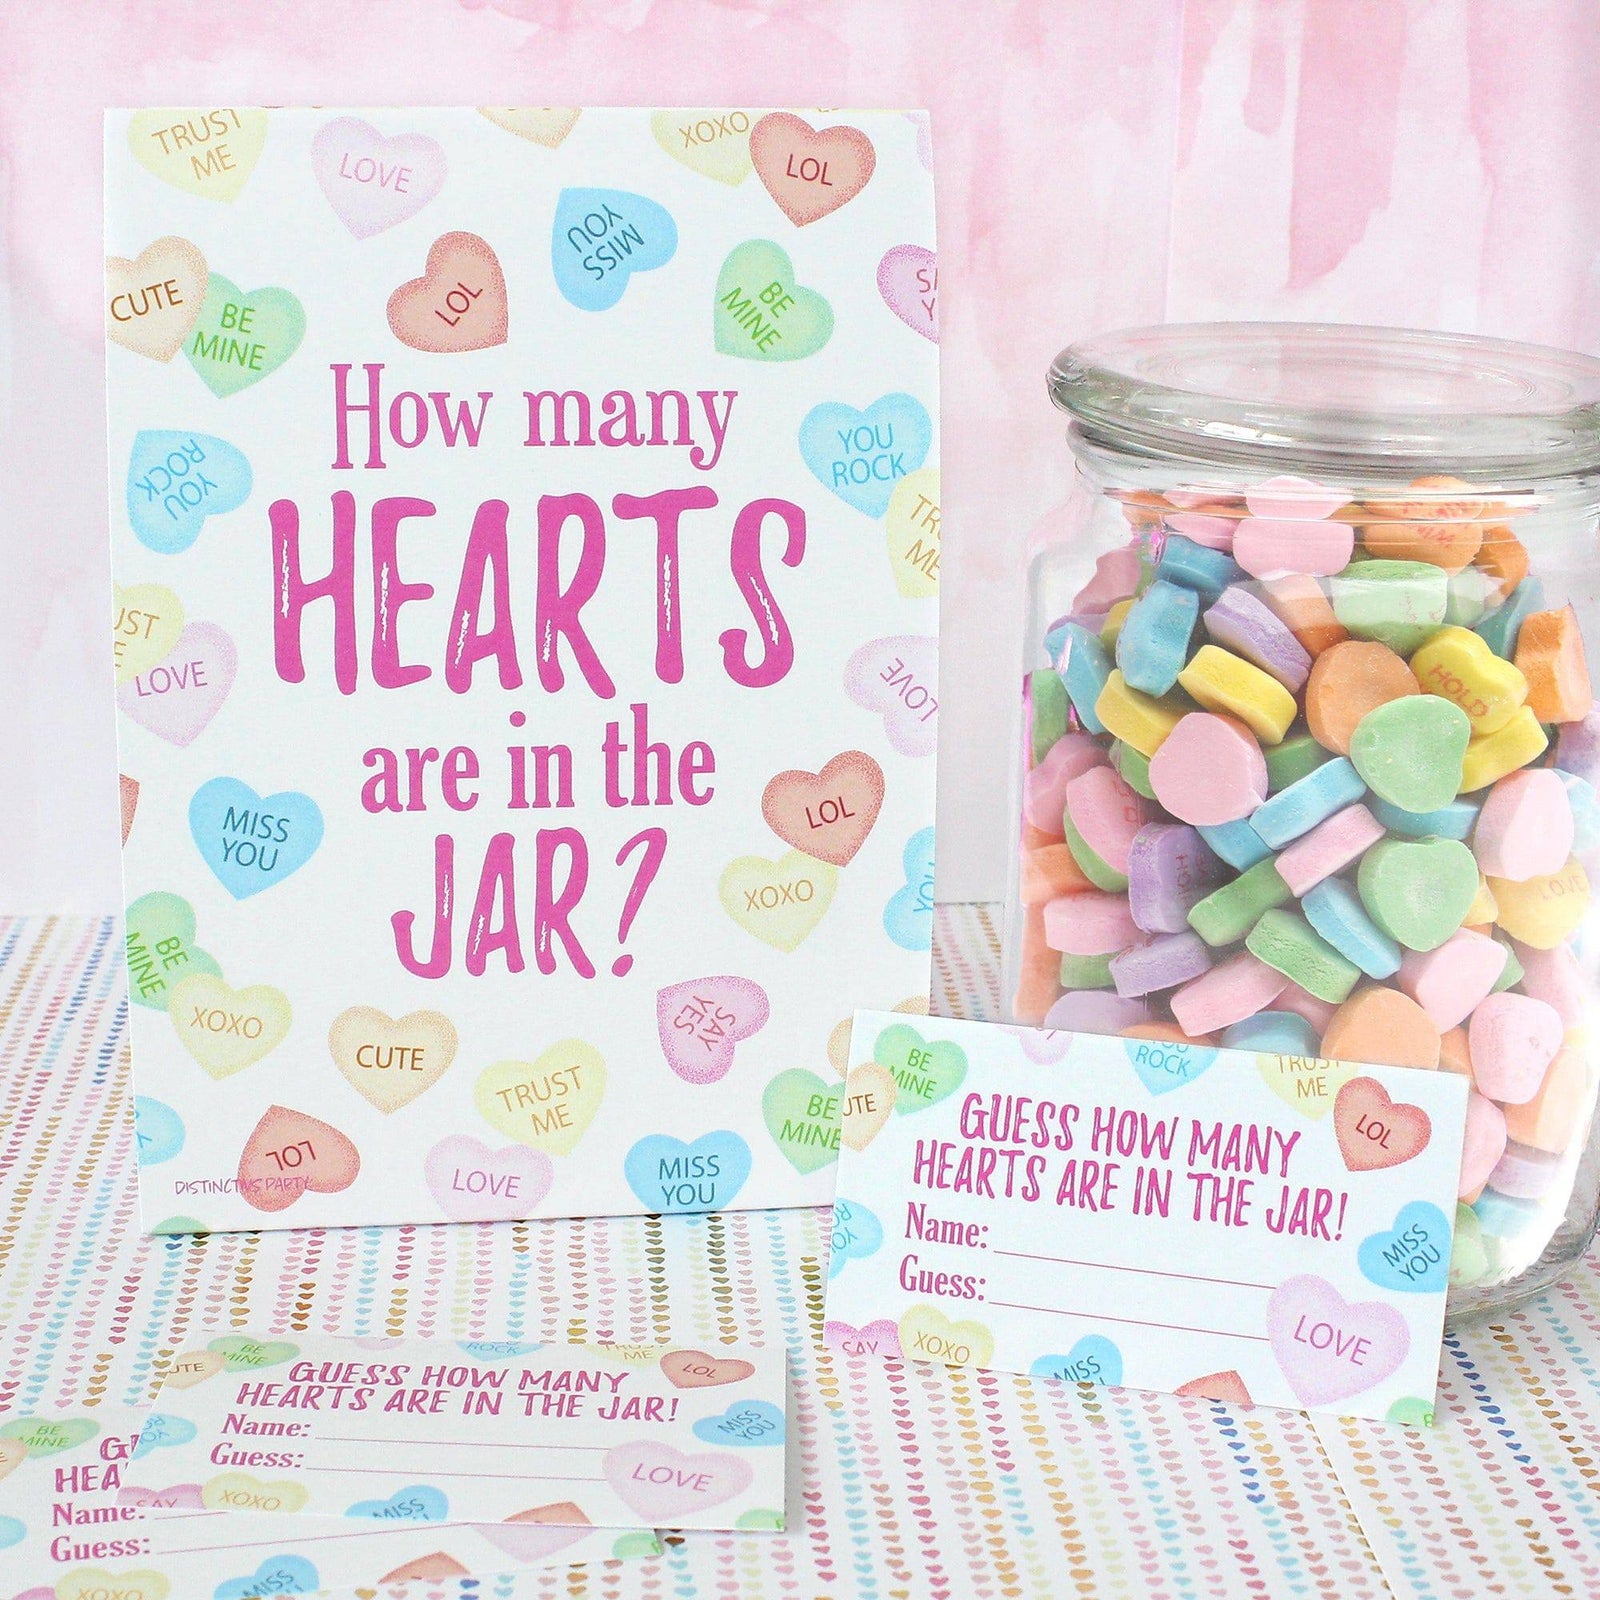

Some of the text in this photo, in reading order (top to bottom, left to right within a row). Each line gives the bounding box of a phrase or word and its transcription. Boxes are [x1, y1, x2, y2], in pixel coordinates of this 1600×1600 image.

[152, 107, 242, 156] TRUST
[679, 111, 750, 149] XOXO
[190, 144, 237, 181] ME
[338, 153, 413, 194] LOVE
[786, 154, 833, 187] LOL
[567, 203, 623, 254] YOU
[583, 223, 645, 281] MISS
[110, 279, 183, 322] CUTE
[434, 282, 484, 328] LOL
[758, 281, 795, 318] BE
[219, 302, 256, 334] BE
[720, 287, 782, 353] MINE
[192, 330, 266, 372] MINE
[329, 363, 739, 471] How many
[837, 423, 894, 455] YOU
[135, 438, 207, 502] ROCK
[832, 453, 908, 488] ROCK
[163, 472, 219, 521] YOU
[268, 485, 807, 699] HEARTS
[135, 661, 208, 697] LOVE
[879, 657, 940, 723] LOVE
[1427, 664, 1489, 718] HOLD
[361, 703, 716, 814] are in the
[223, 806, 291, 843] MISS
[805, 796, 855, 829] LOL
[222, 837, 278, 872] YOU
[391, 827, 667, 980] JAR?
[744, 879, 815, 912] XOXO
[126, 931, 167, 999] MINE
[155, 936, 189, 971] BE
[190, 1006, 263, 1039] XOXO
[673, 995, 715, 1035] YES
[697, 1006, 736, 1052] SAY
[356, 1044, 425, 1072] CUTE
[907, 1048, 933, 1072] BE
[1135, 1044, 1192, 1077] ROCK
[496, 1066, 584, 1113] TRUST
[1297, 1076, 1328, 1098] ME
[530, 1103, 574, 1136] ME
[806, 1094, 839, 1120] BE
[780, 1119, 841, 1151] MINE
[960, 1092, 1301, 1177] GUESS HOW MANY
[1355, 1113, 1393, 1150] LOL
[265, 1140, 317, 1172] LOL
[659, 1154, 721, 1181] MISS
[265, 1176, 310, 1191] PARTY
[452, 1168, 522, 1199] LOVE
[661, 1182, 716, 1207] YOU
[913, 1139, 1348, 1242] HEARTS ARE IN THE JAR!
[904, 1201, 990, 1250] Name:
[1381, 1222, 1429, 1268] MISS
[1398, 1243, 1442, 1282] YOU
[899, 1253, 986, 1301] Guess:
[241, 1344, 266, 1354] BE
[624, 1351, 656, 1360] ME
[913, 1331, 971, 1364] XOXO
[1293, 1314, 1372, 1367] LOVE
[288, 1361, 631, 1395] GUESS HOW MANY
[682, 1362, 718, 1379] LOL
[235, 1382, 680, 1423] HEARTS ARE IN THE JAR!
[36, 1425, 61, 1436] BE
[220, 1413, 312, 1438] Name:
[717, 1409, 762, 1434] MISS
[735, 1419, 776, 1441] YOU
[209, 1442, 304, 1468] Guess:
[631, 1462, 714, 1492] LOVE
[218, 1489, 280, 1512] XOXO
[50, 1536, 151, 1562] Guess:
